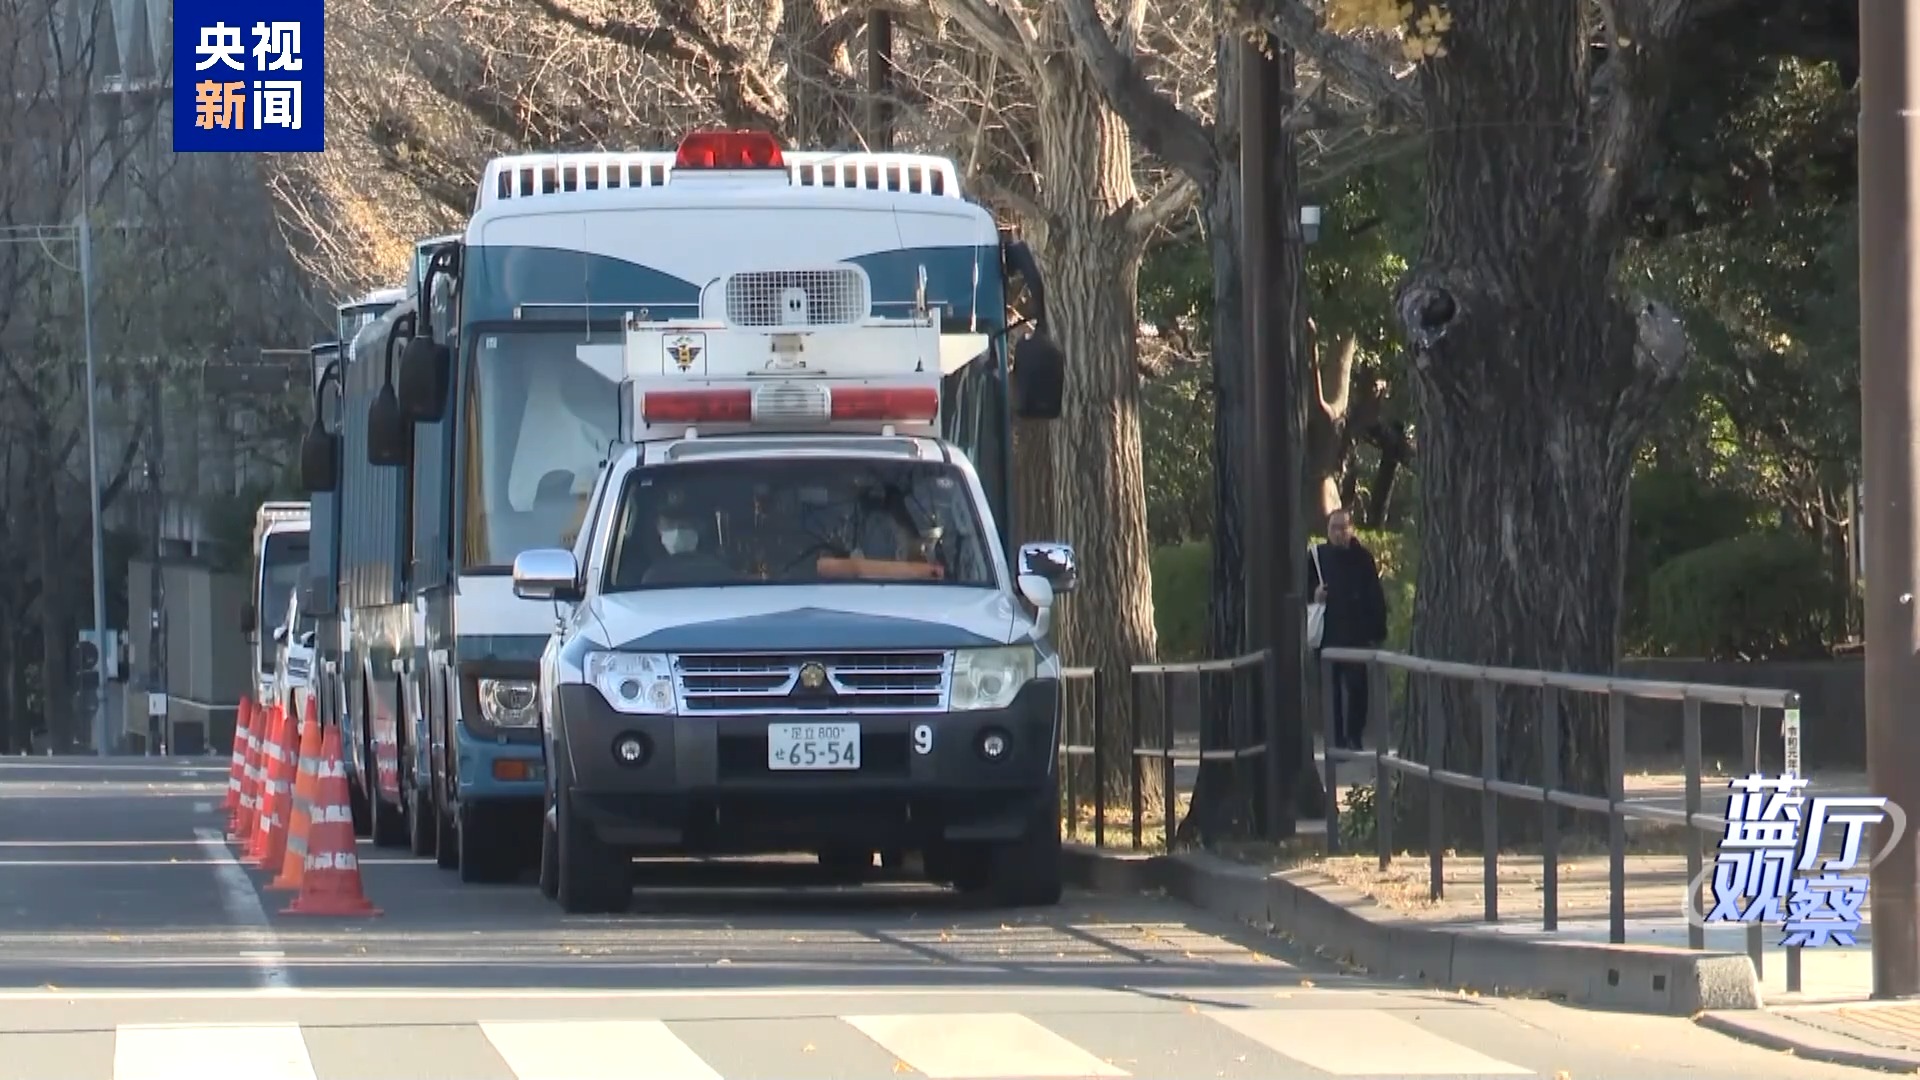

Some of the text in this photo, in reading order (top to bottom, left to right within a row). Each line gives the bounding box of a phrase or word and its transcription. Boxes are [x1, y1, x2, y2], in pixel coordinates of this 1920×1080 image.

[818, 727, 840, 739] 800
[914, 725, 933, 754] 9
[789, 741, 855, 765] 65-54
